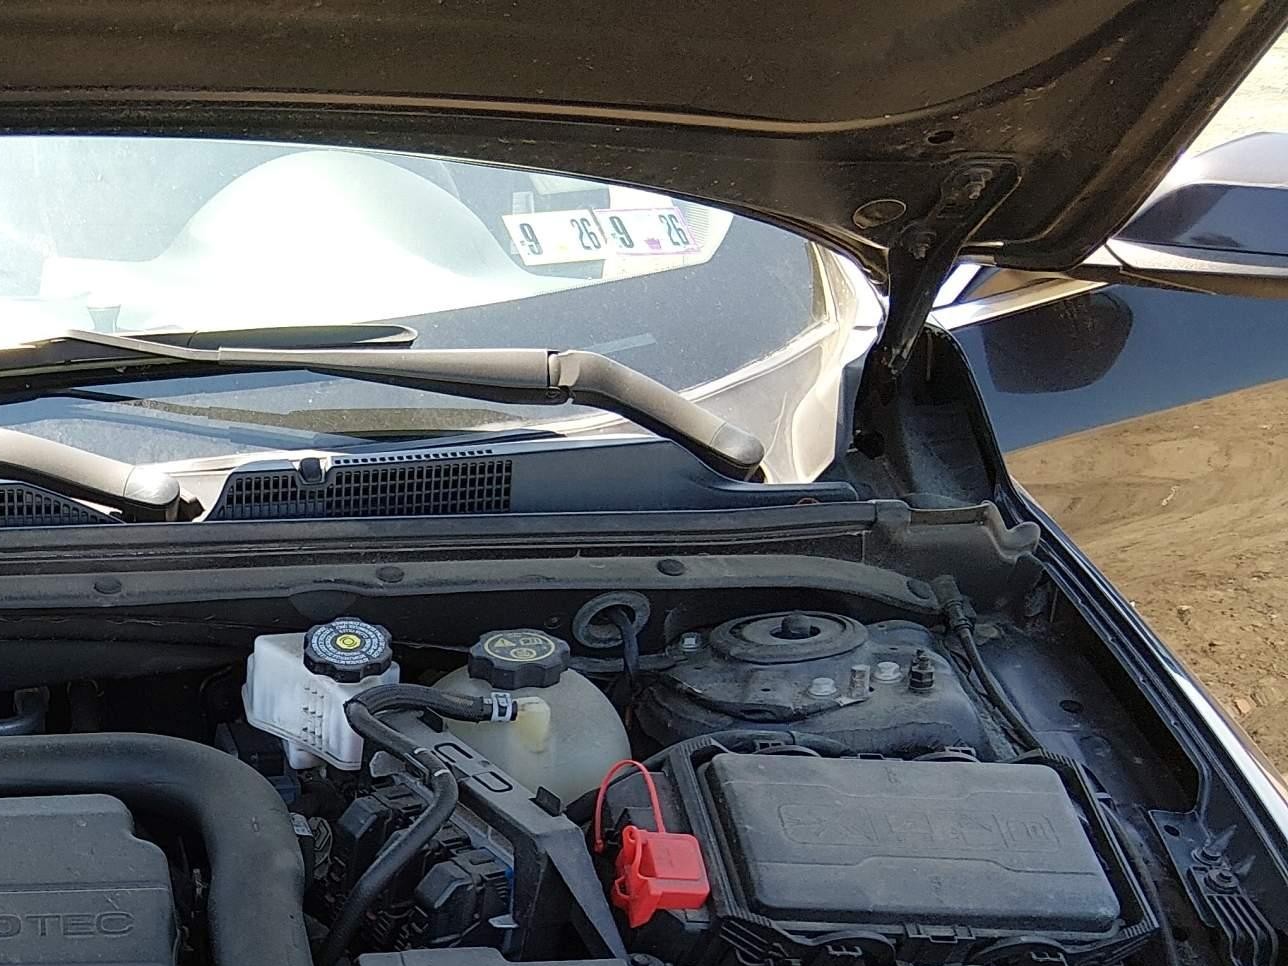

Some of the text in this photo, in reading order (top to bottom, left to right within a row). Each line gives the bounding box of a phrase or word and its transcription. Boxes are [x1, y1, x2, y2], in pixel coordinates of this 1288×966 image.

[519, 217, 602, 256] 9 26
[610, 213, 690, 249] 9 26
